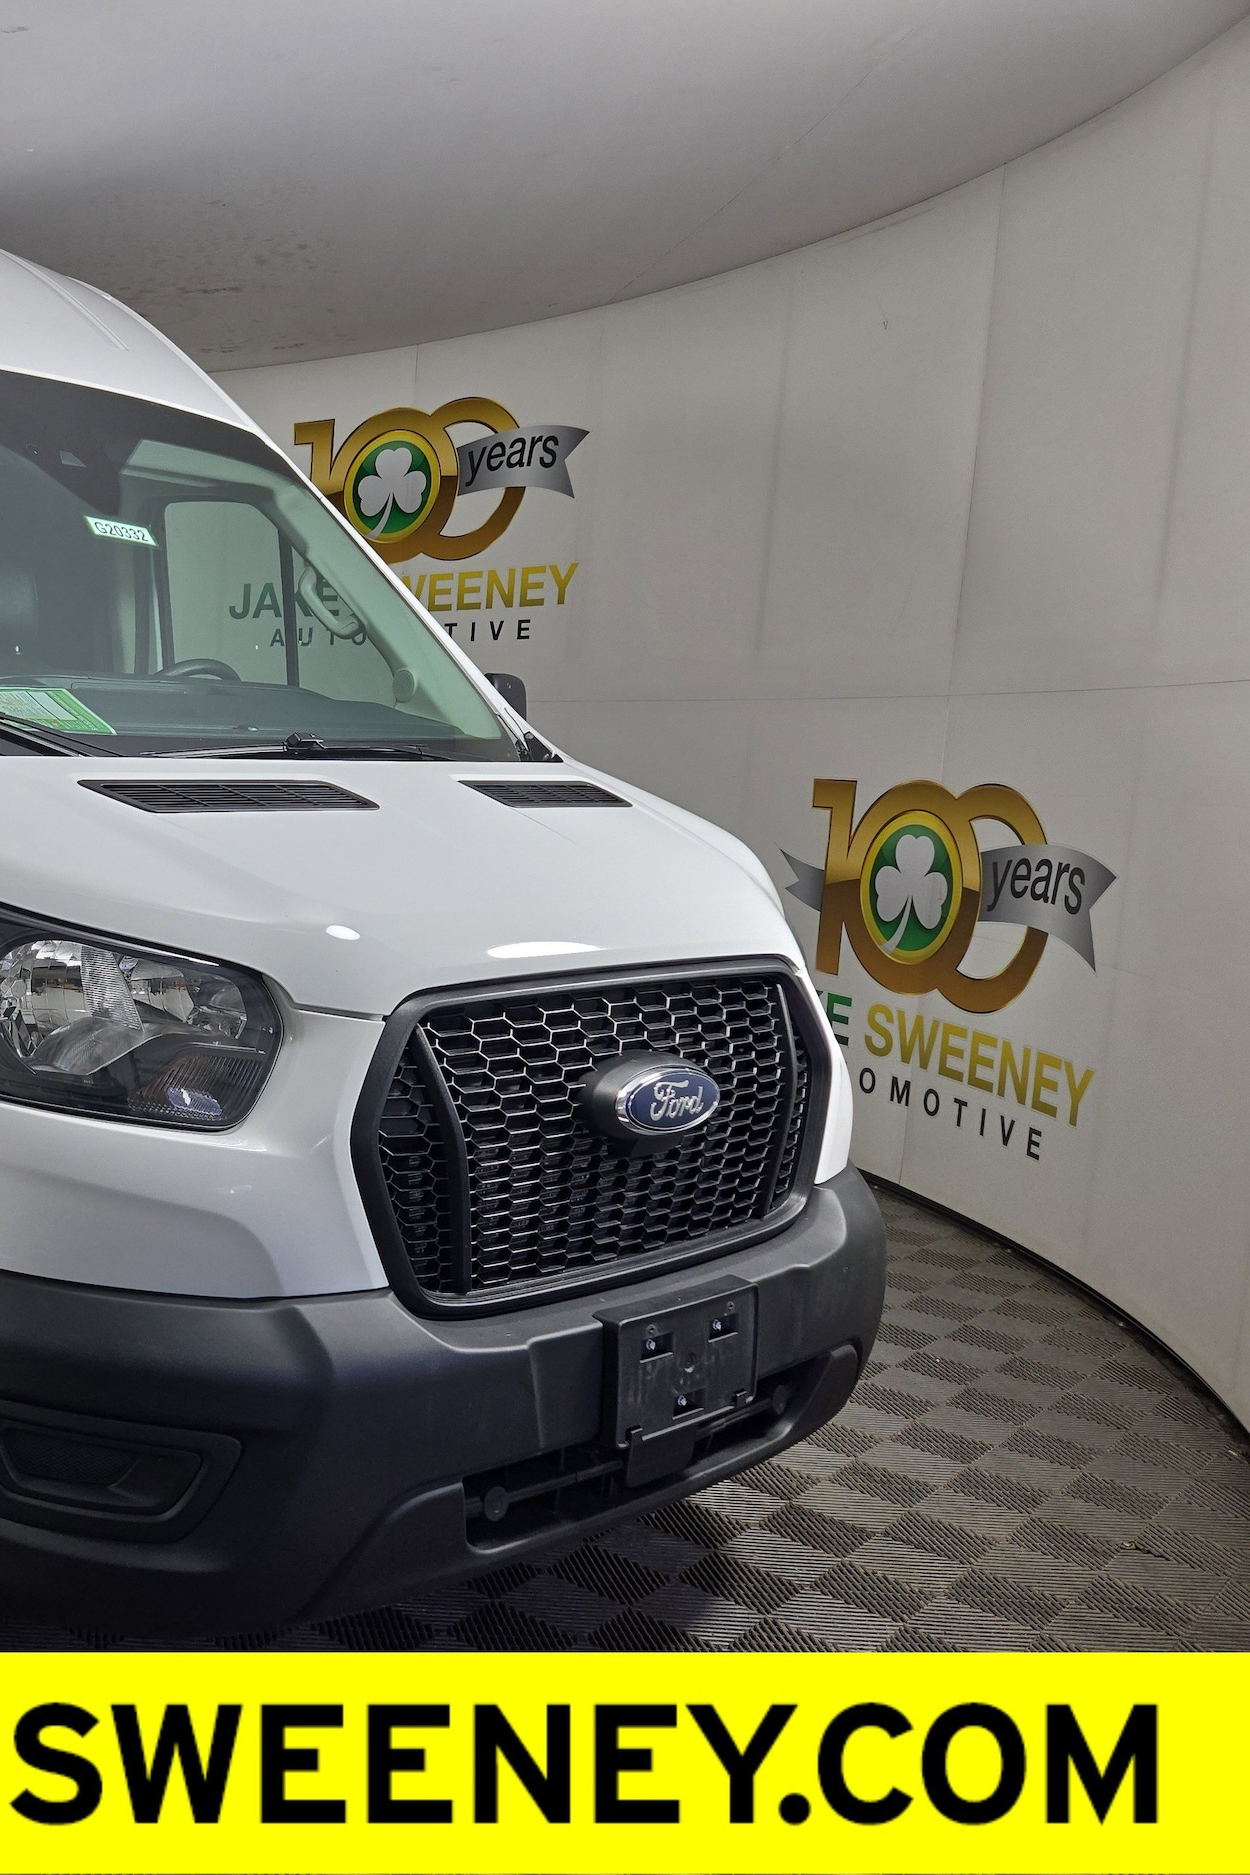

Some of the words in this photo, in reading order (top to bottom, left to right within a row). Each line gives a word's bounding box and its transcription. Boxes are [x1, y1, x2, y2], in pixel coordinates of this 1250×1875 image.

[465, 433, 559, 487] years
[94, 521, 149, 542] G20332
[402, 563, 579, 612] EENEY
[812, 779, 1049, 1014] 100
[986, 856, 1086, 916] years
[864, 1003, 1094, 1127] SWEENEY
[650, 1079, 704, 1121] Ford
[859, 1068, 1042, 1161] OMOTIVE
